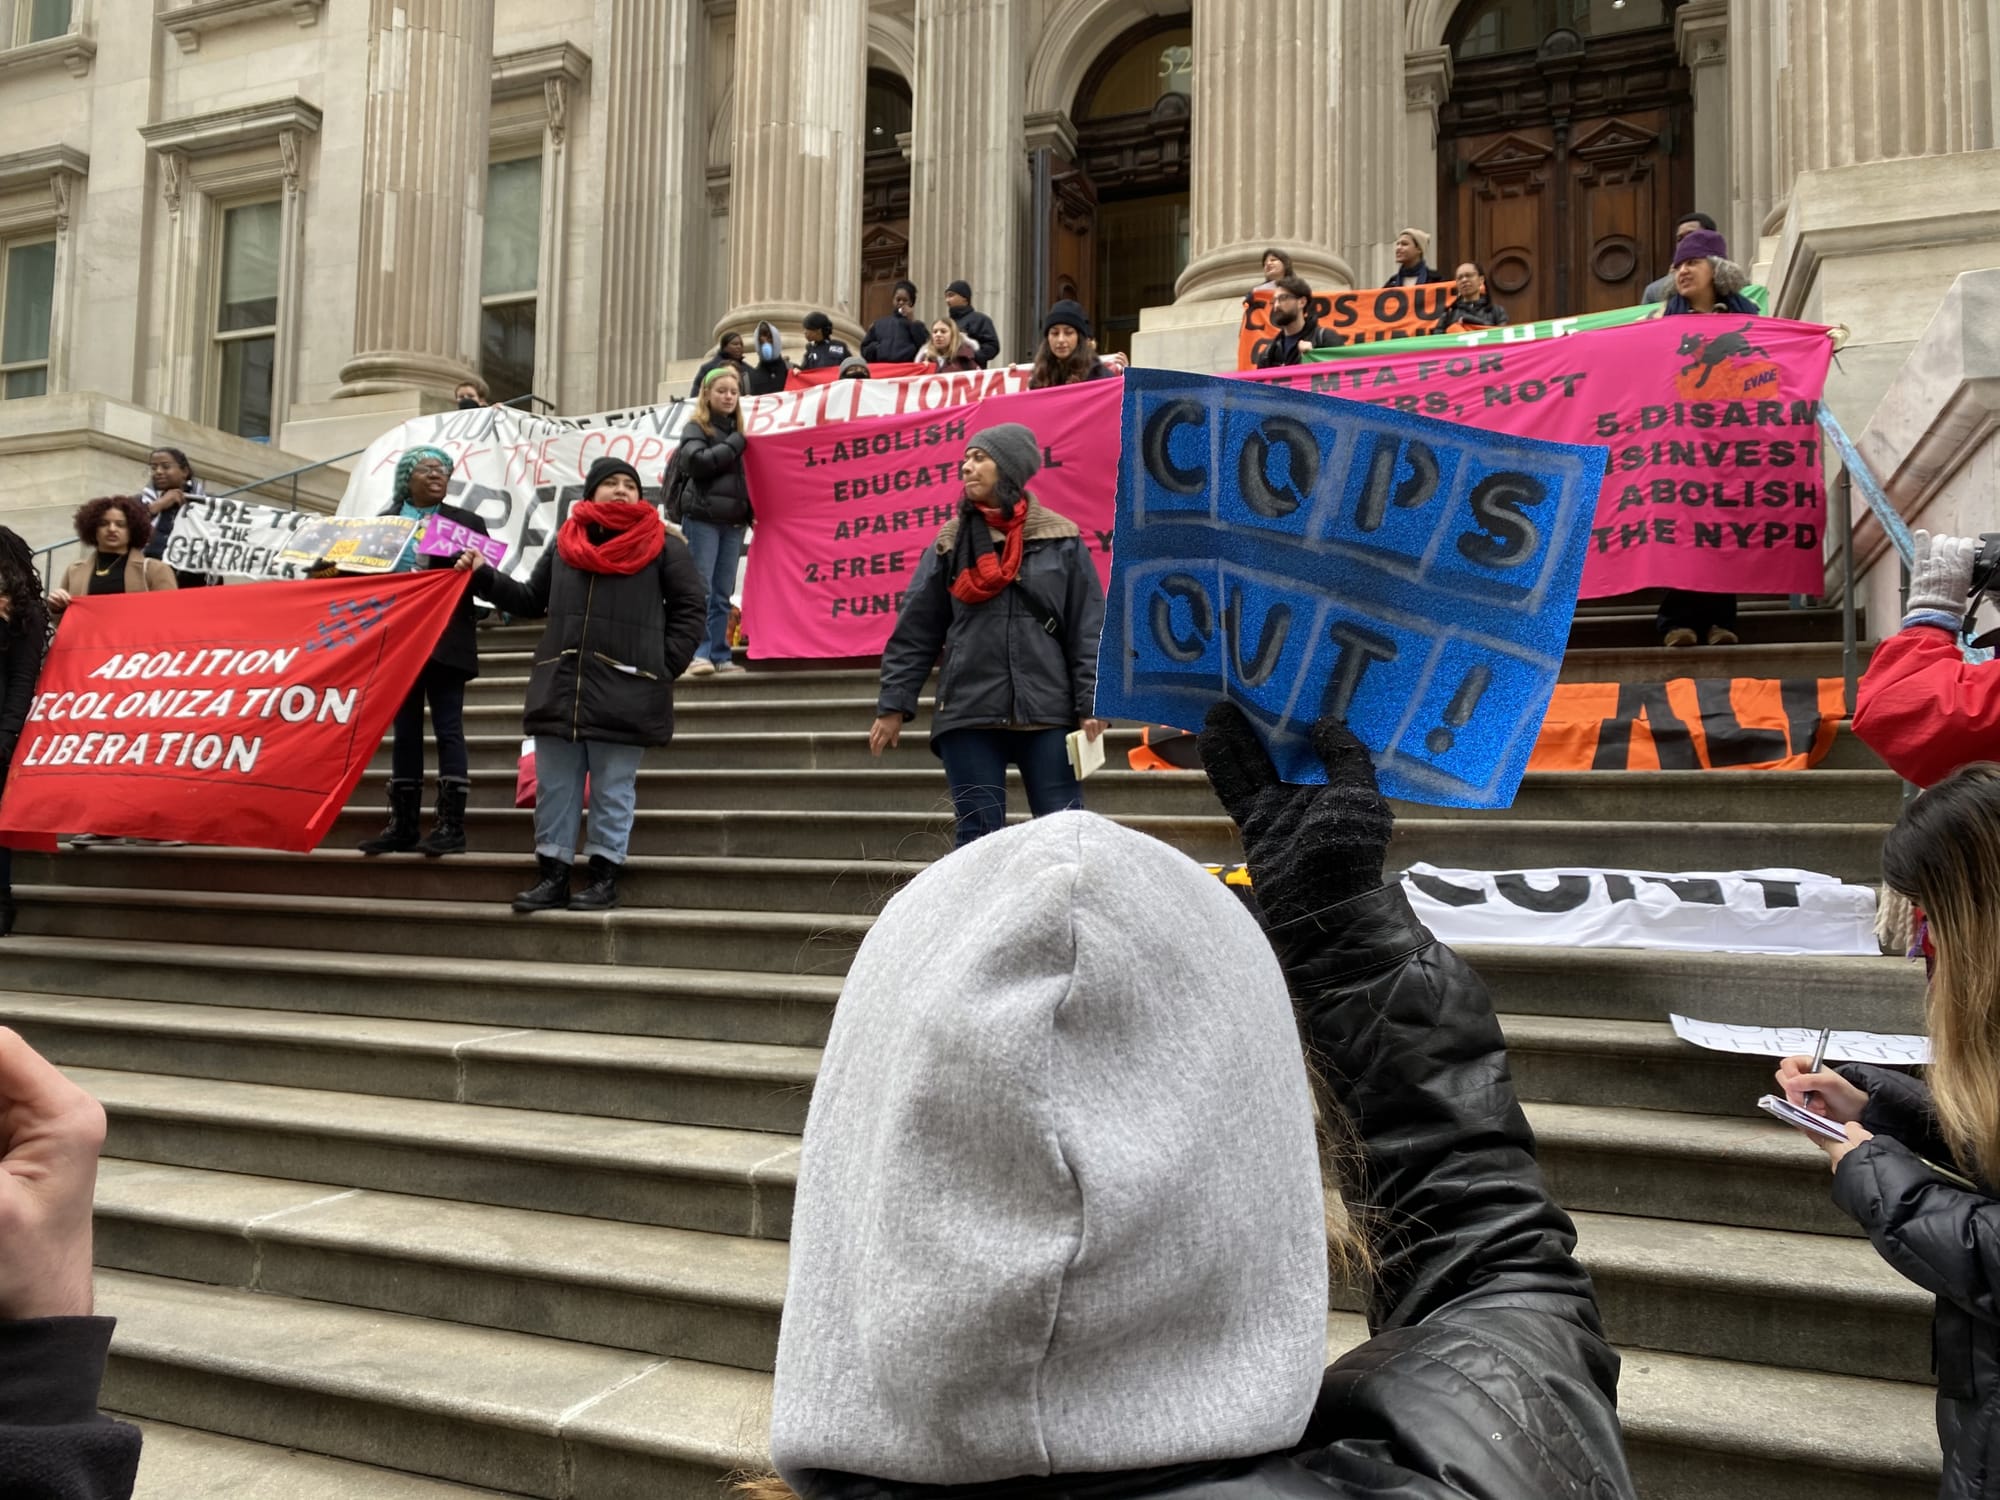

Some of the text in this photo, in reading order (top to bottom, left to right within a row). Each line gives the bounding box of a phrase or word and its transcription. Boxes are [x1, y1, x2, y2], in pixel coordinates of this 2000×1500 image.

[1374, 287, 1458, 322] OU
[1418, 352, 1505, 381] FOR
[1743, 367, 1778, 392] EVADE
[1483, 372, 1587, 408] NOT
[1142, 398, 1548, 568] COPS
[1618, 478, 1818, 512] ABOLISH
[219, 525, 250, 542] THE
[437, 518, 501, 560] FREE
[1694, 521, 1819, 550] NYPD
[88, 647, 300, 680] ABOLITION
[1149, 573, 1493, 755] OUT!
[22, 732, 262, 773] LIBERATION
